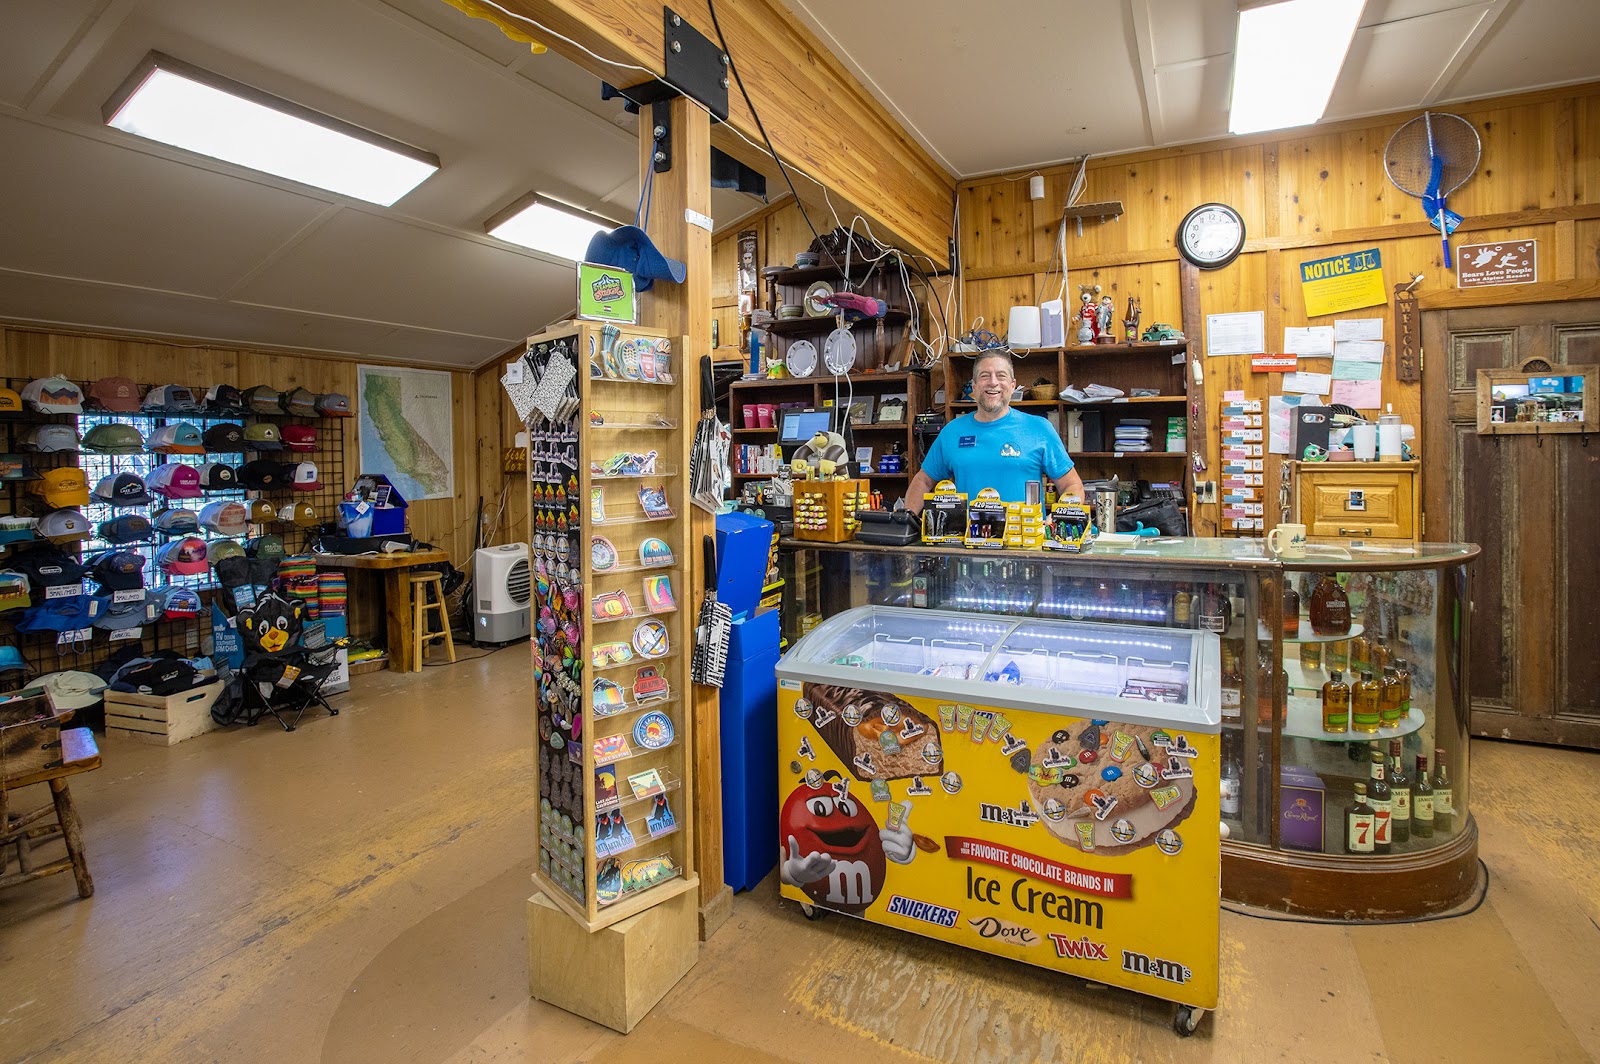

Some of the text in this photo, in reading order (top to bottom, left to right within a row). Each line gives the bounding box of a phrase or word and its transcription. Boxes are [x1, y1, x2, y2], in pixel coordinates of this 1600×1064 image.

[1304, 258, 1352, 280] NOTICE
[1400, 302, 1414, 378] WELCOME
[612, 751, 630, 760] ALPINE
[1377, 769, 1382, 778] 7
[650, 822, 662, 833] MTN
[663, 817, 674, 828] DOG
[1355, 823, 1370, 844] 7
[1375, 812, 1390, 840] 7
[608, 836, 633, 851] MTN DOG
[971, 843, 1114, 892] FAVORITE CHOCOLATE BRANDS IN
[826, 860, 873, 904] m
[967, 866, 1104, 929] Ice Cream
[890, 897, 957, 927] SNICKERS
[968, 917, 1038, 941] Dove
[1050, 933, 1109, 960] Twix
[1123, 950, 1192, 984] m&m's
